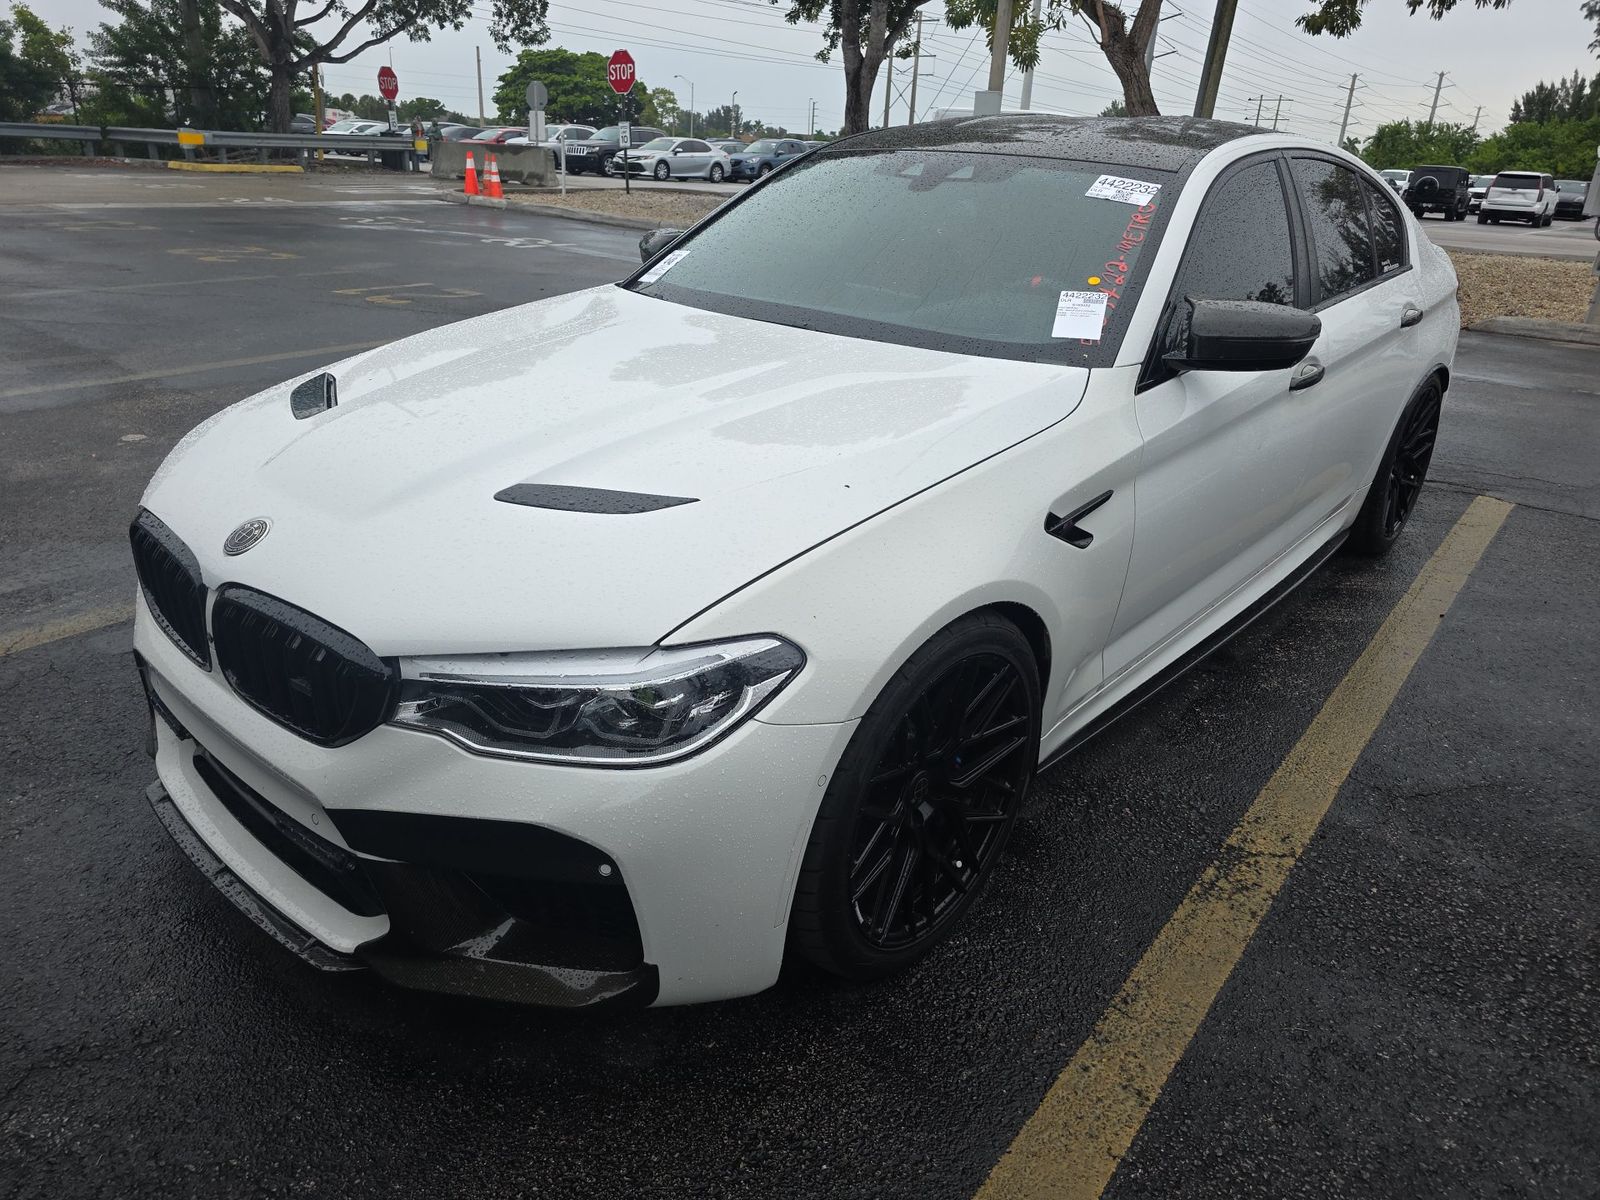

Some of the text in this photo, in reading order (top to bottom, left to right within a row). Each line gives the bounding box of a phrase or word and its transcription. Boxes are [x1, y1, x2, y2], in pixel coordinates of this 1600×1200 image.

[610, 63, 634, 80] STOP
[380, 76, 397, 90] STOP
[621, 133, 629, 144] 10
[1098, 178, 1160, 195] 4422232
[1062, 292, 1108, 300] 4422232
